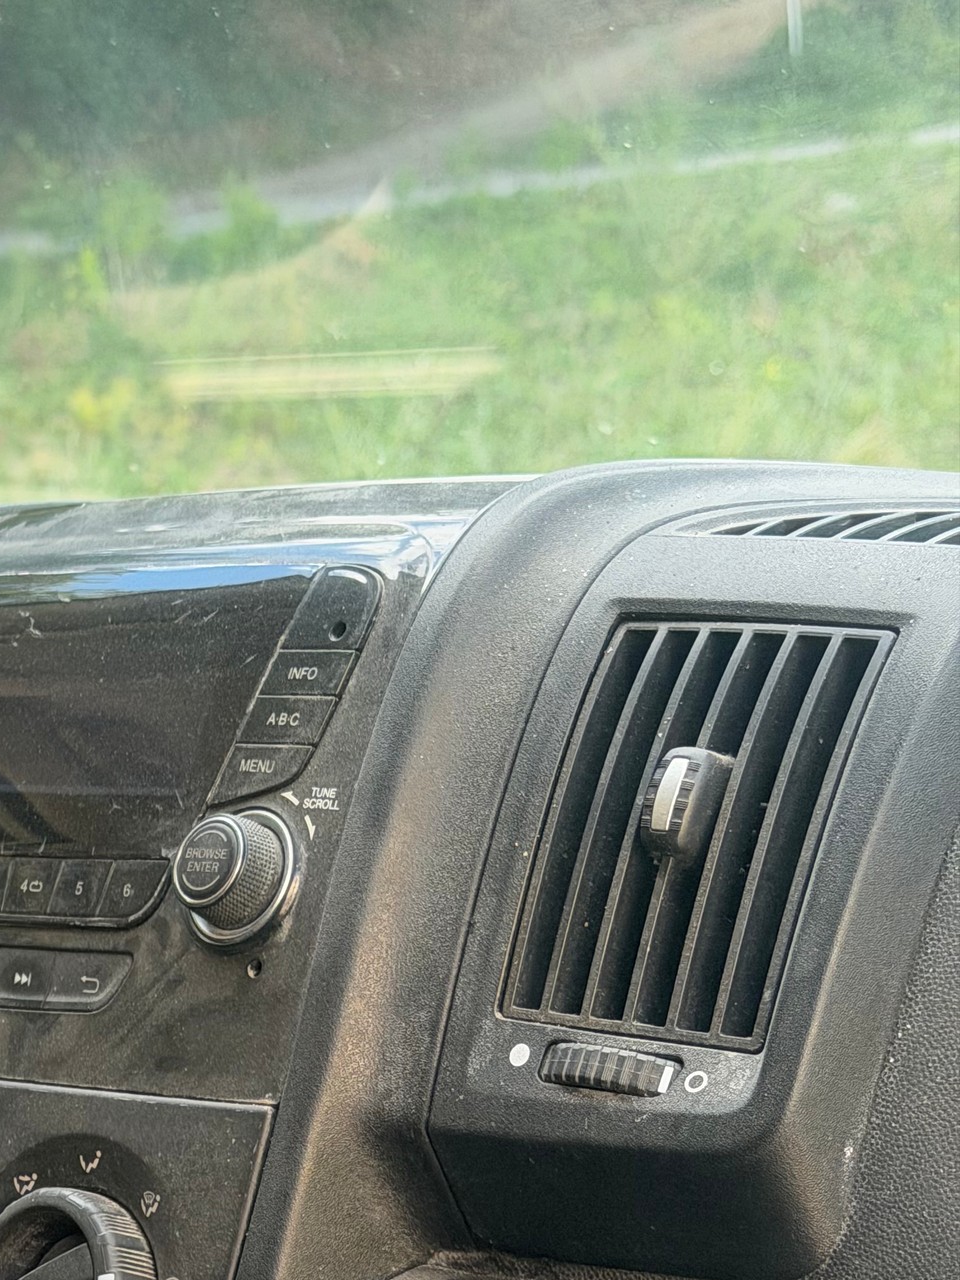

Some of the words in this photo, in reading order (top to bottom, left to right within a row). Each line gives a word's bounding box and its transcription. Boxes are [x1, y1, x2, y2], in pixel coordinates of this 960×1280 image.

[287, 667, 318, 680] INFO
[239, 759, 276, 774] MENU
[311, 786, 337, 799] TUNE
[302, 798, 340, 811] SCROLL
[185, 848, 228, 860] BROWSE
[186, 861, 220, 873] ENTER
[20, 877, 29, 892] 4
[74, 881, 84, 896] 5
[122, 883, 132, 898] 6
